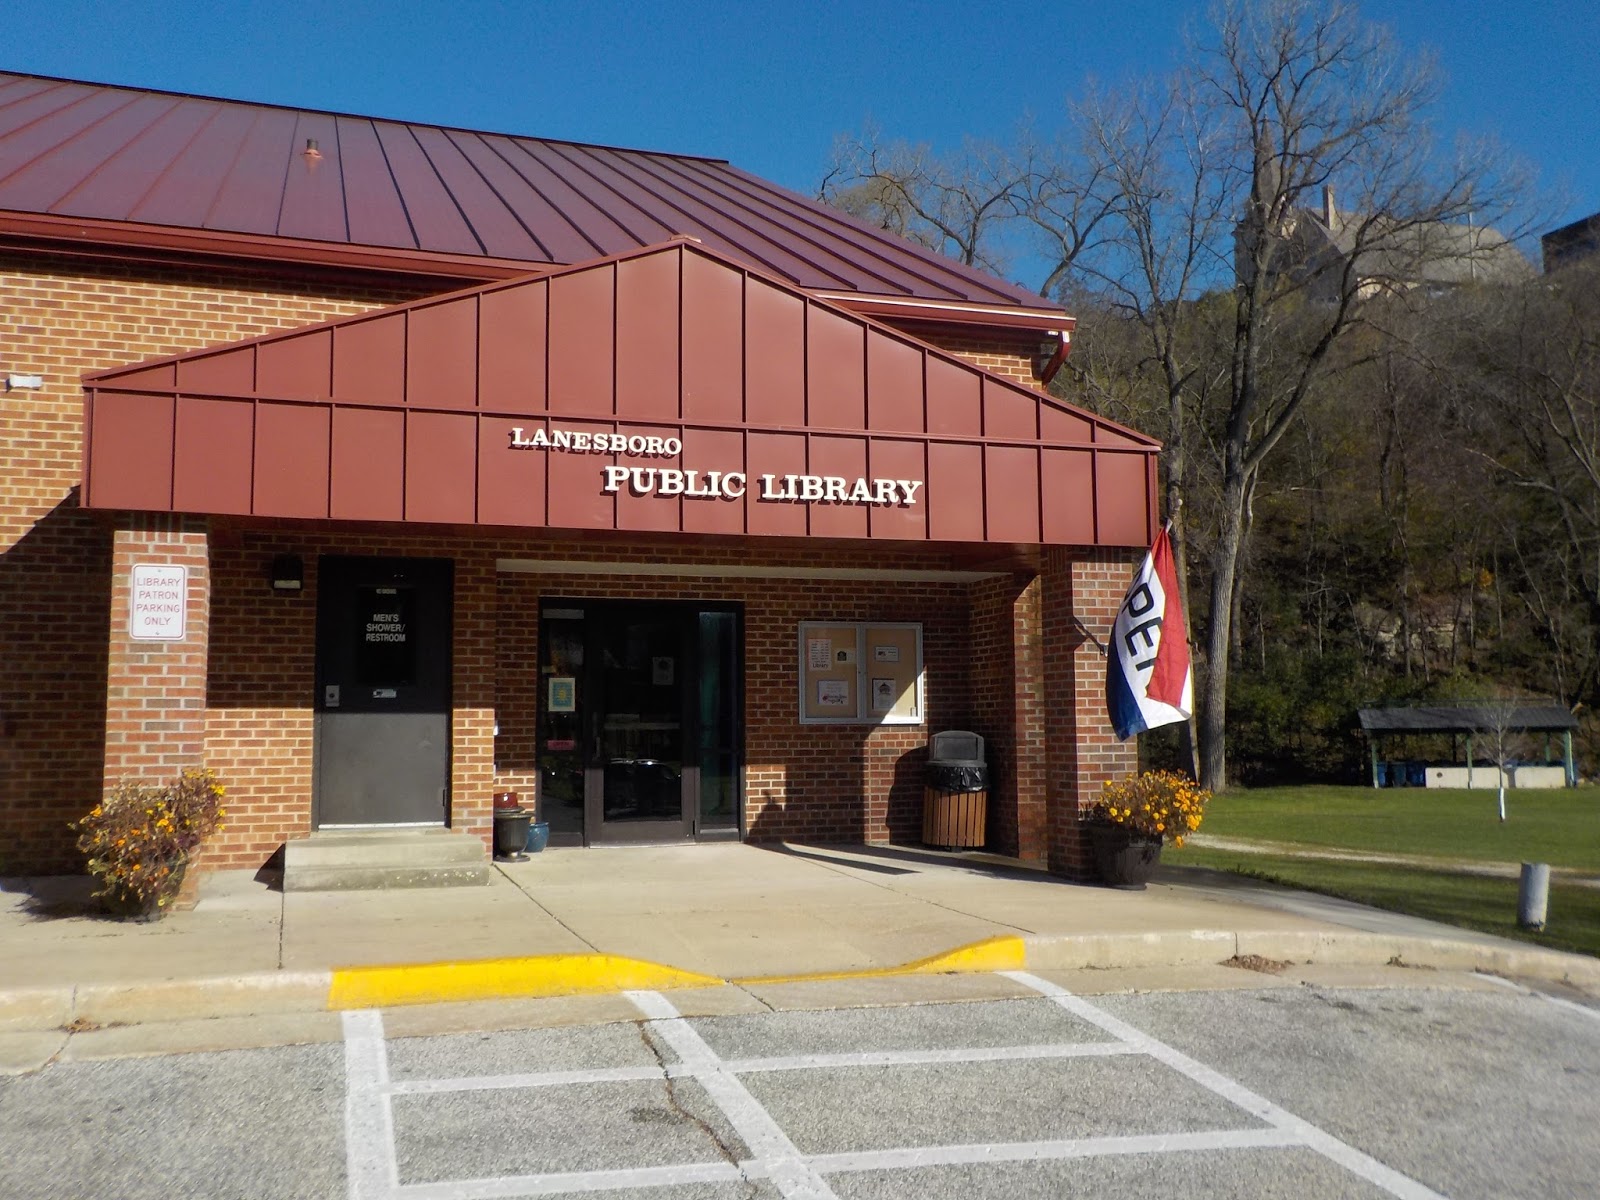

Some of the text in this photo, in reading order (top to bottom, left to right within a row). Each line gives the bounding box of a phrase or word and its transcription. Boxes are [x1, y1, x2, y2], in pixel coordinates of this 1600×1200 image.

[511, 426, 682, 456] LANESBORO
[603, 465, 923, 505] PUBLIC LIBRARY
[136, 577, 181, 587] LIBRARY
[138, 590, 179, 600] PATRON
[136, 603, 180, 613] PARKING
[144, 616, 172, 626] ONLY
[373, 613, 400, 622] MEN'S
[366, 622, 406, 633] SHOWER/
[365, 633, 406, 642] RESTROOM
